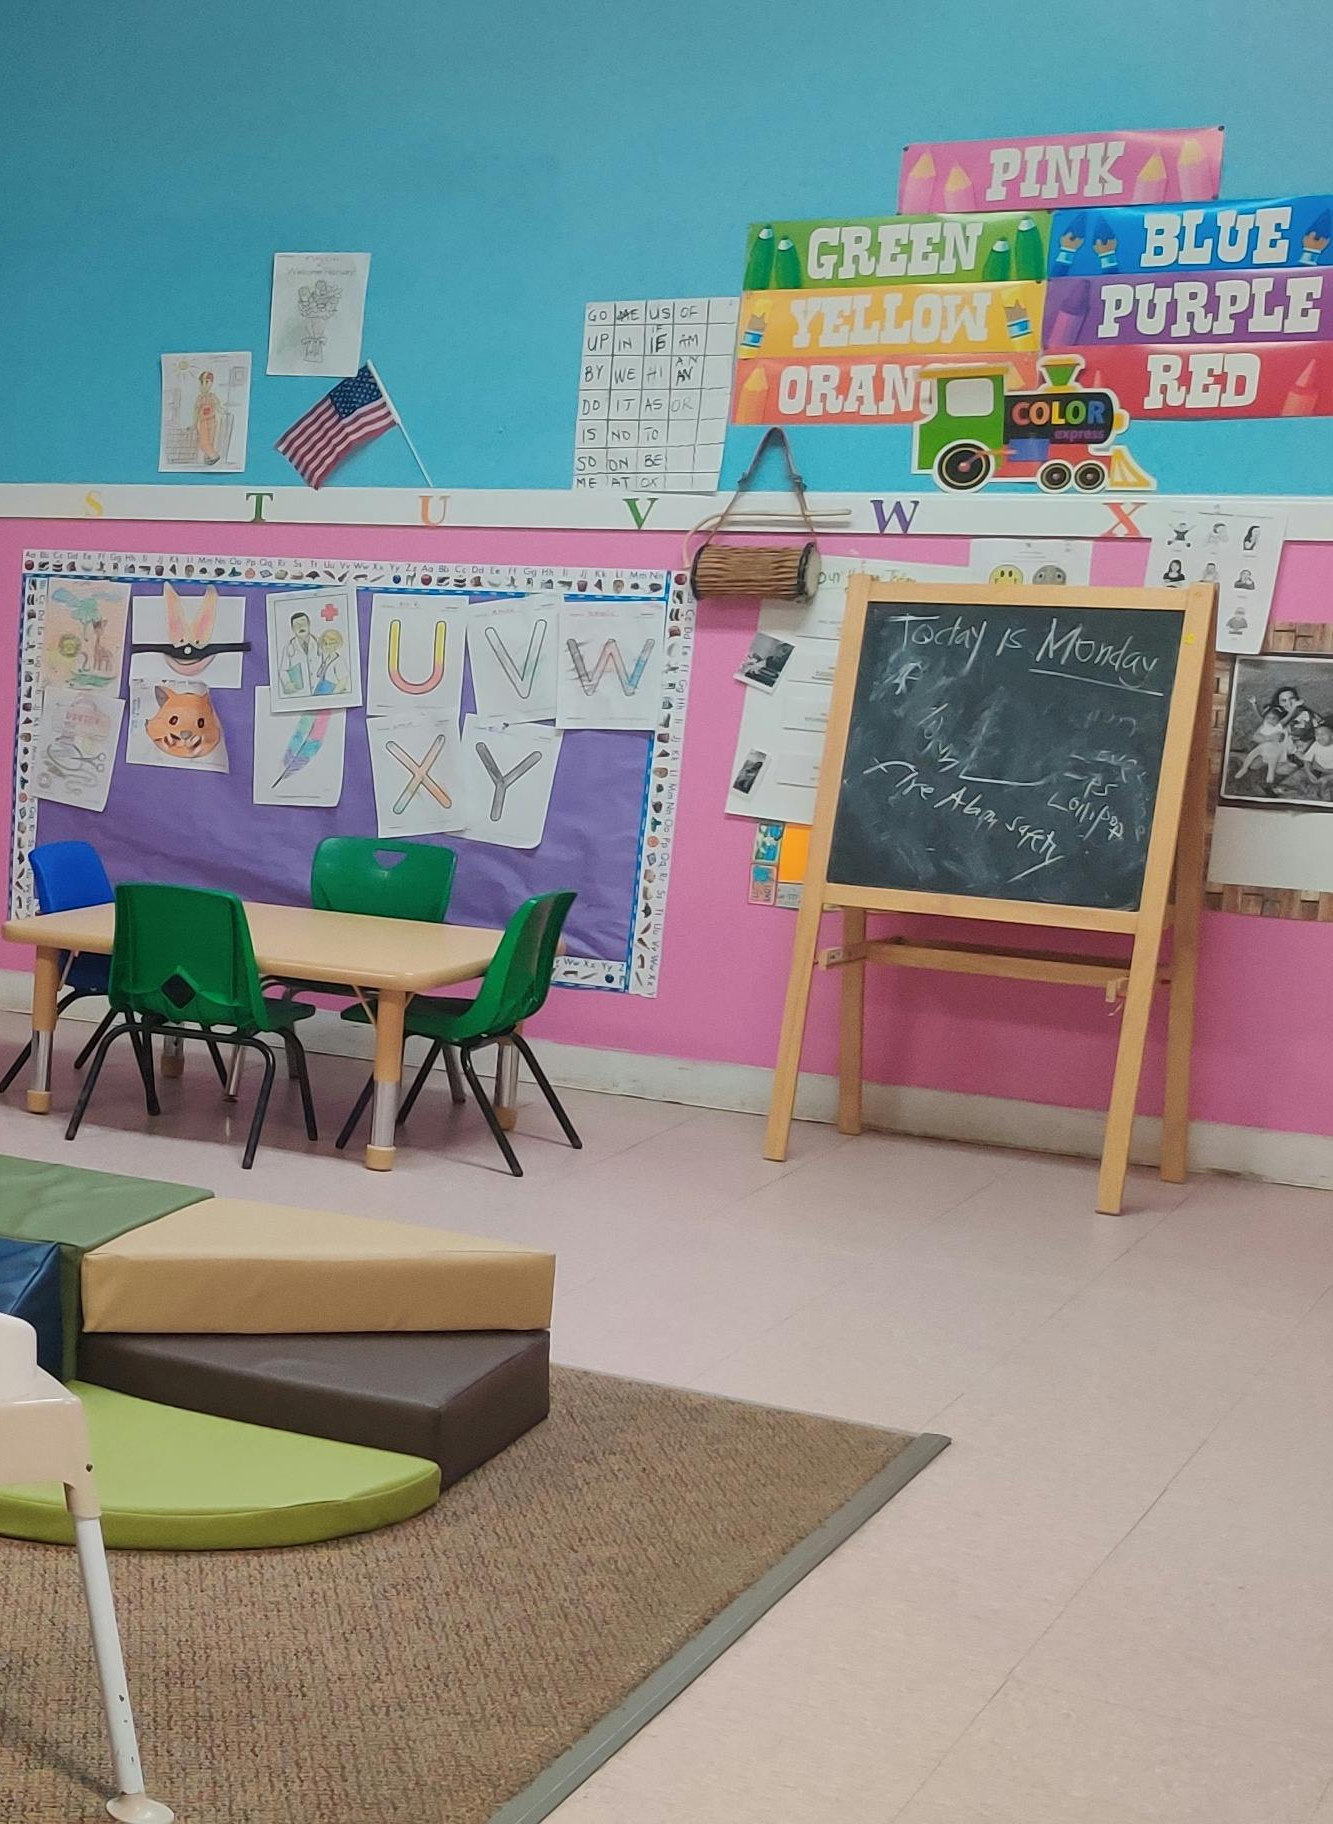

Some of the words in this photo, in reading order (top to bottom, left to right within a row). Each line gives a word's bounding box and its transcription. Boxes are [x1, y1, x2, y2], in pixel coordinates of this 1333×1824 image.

[985, 141, 1125, 201] PINK
[807, 222, 983, 279] GREEN
[1140, 206, 1293, 267] BLUE
[588, 310, 608, 321] GO
[649, 307, 671, 320] US
[680, 306, 698, 318] OF
[790, 291, 992, 348] YELLOW
[1098, 276, 1323, 338] PURPLE
[587, 333, 609, 351] UP
[618, 337, 632, 351] IN
[678, 334, 699, 347] AM
[584, 364, 604, 382] BY
[614, 368, 636, 384] WE
[646, 366, 663, 383] HI
[778, 364, 933, 416] ORAN
[1143, 353, 1261, 409] RED
[583, 399, 600, 415] DO
[616, 398, 635, 411] IT
[645, 399, 663, 412] AS
[671, 398, 694, 412] OR
[1011, 401, 1105, 425] COLOR
[582, 428, 597, 444] IS
[612, 429, 631, 441] NO
[644, 427, 659, 441] TO
[1055, 429, 1105, 441] express
[576, 455, 597, 471] SO
[608, 459, 629, 471] ON
[644, 454, 663, 467] BE
[576, 477, 597, 488] ME
[612, 477, 631, 489] AT
[84, 491, 104, 517] S
[245, 492, 274, 523] T
[418, 495, 450, 527] U
[622, 497, 659, 529] V
[870, 500, 920, 533] W
[1100, 502, 1148, 536] X
[388, 619, 447, 695] U
[484, 619, 547, 699] V
[566, 638, 655, 696] W
[886, 613, 987, 676] Today
[1035, 617, 1159, 688] Monday
[385, 734, 452, 814] X
[475, 742, 542, 821] Y
